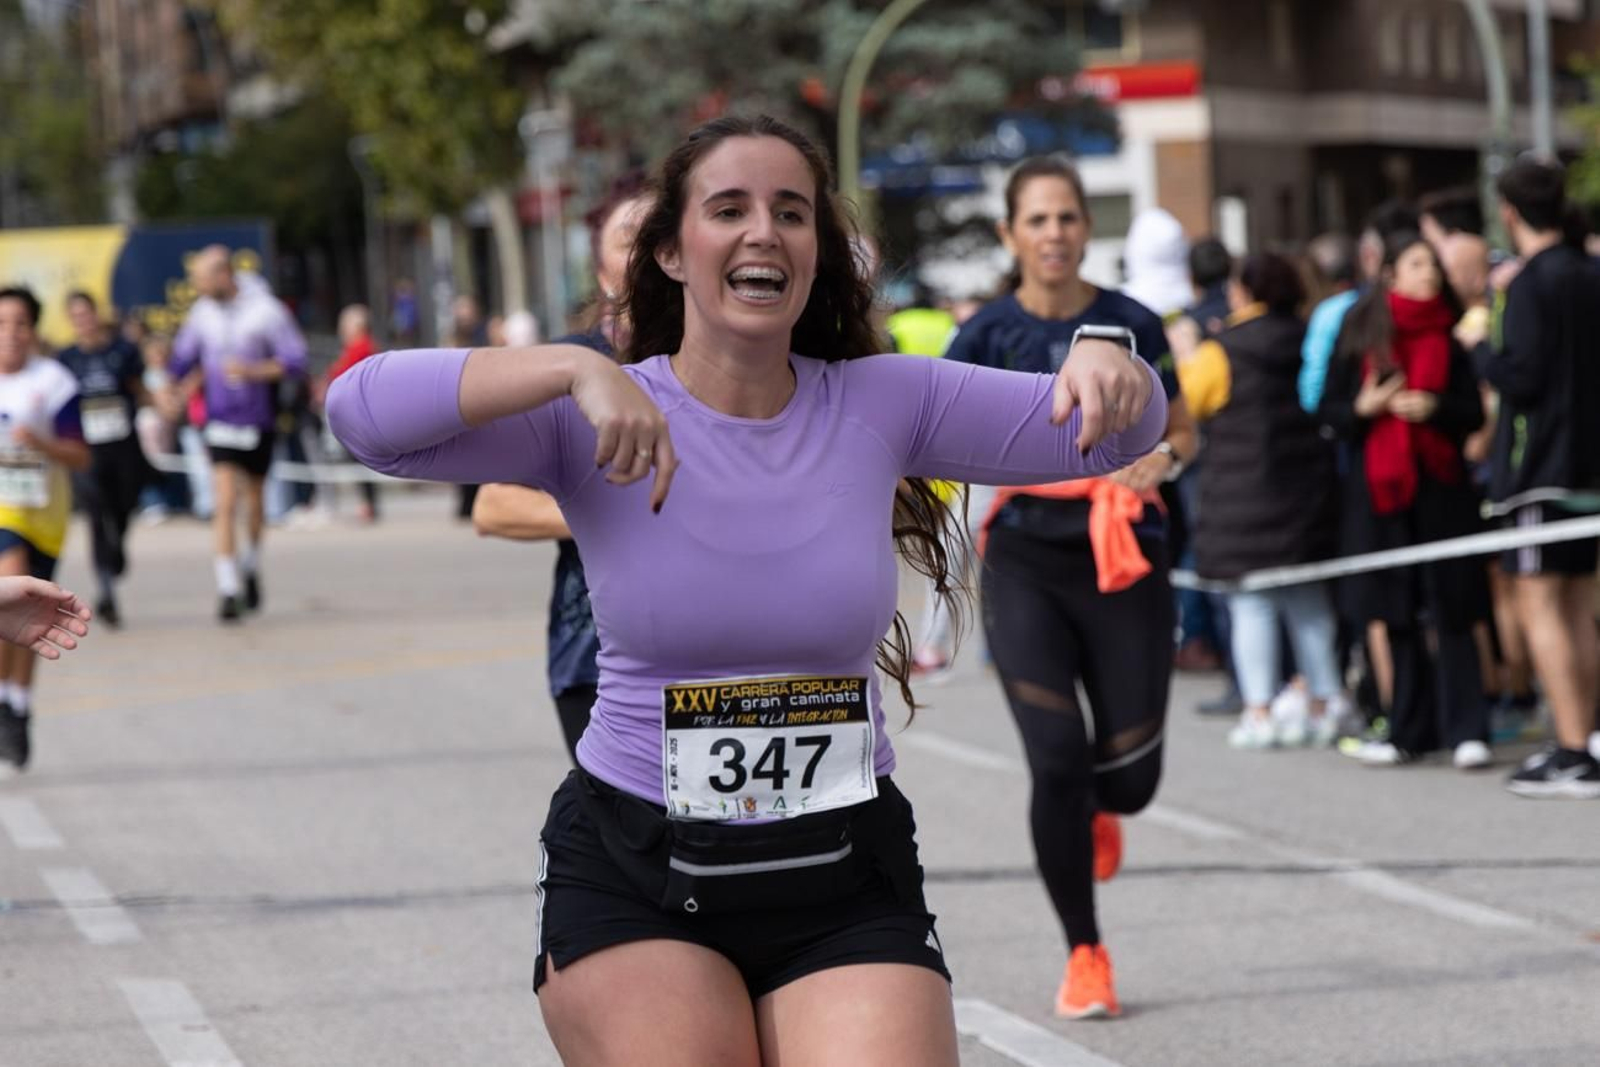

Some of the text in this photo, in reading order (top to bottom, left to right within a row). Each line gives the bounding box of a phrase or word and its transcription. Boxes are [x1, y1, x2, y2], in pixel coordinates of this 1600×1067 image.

[671, 680, 860, 713] XXV CARRERA POPULAR
[720, 690, 860, 713] y gran caminata
[708, 734, 833, 794] 347
